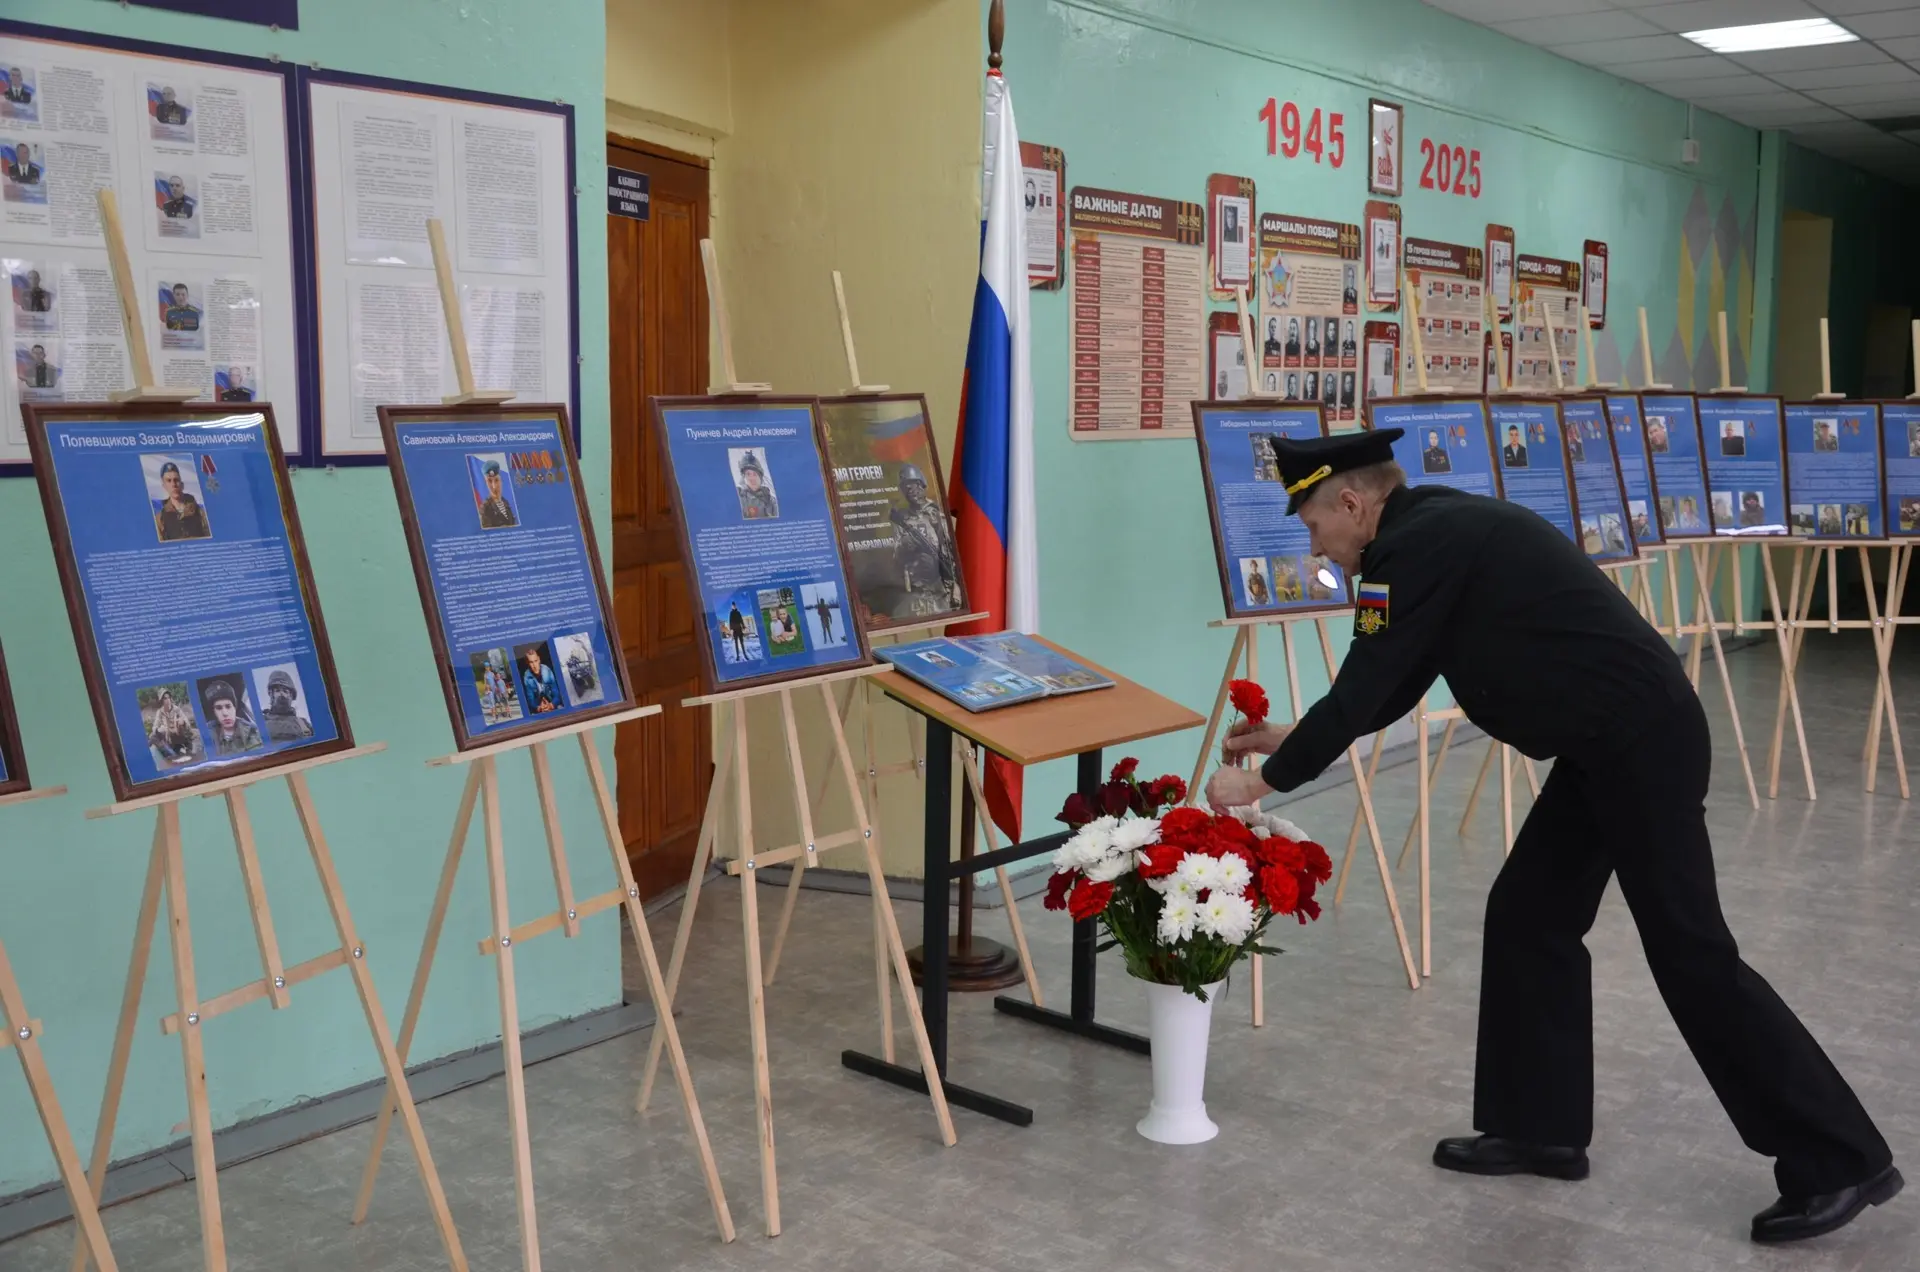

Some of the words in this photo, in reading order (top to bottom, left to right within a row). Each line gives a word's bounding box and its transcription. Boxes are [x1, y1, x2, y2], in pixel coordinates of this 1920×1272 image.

[1258, 97, 1345, 168] 1945
[1419, 137, 1481, 199] 2025
[1074, 194, 1128, 214] ВАЖНЫЕ
[1130, 202, 1162, 219] ДАТЫ
[1263, 219, 1307, 234] МАРШАЛЫ
[1307, 225, 1338, 239] ПОБЕДЫ
[1519, 260, 1542, 273] ГОРОДА
[60, 433, 136, 448] Полевщиков
[139, 432, 174, 446] Захар
[176, 431, 256, 446] Владимирович
[402, 433, 456, 446] Савиновский
[457, 432, 498, 444] Александр
[499, 431, 554, 443] Александрович
[686, 428, 721, 440] Пуничев
[723, 427, 752, 438] Андрей
[753, 427, 797, 436] Алексеевич
[848, 465, 884, 480] ГЕРОЕВ!
